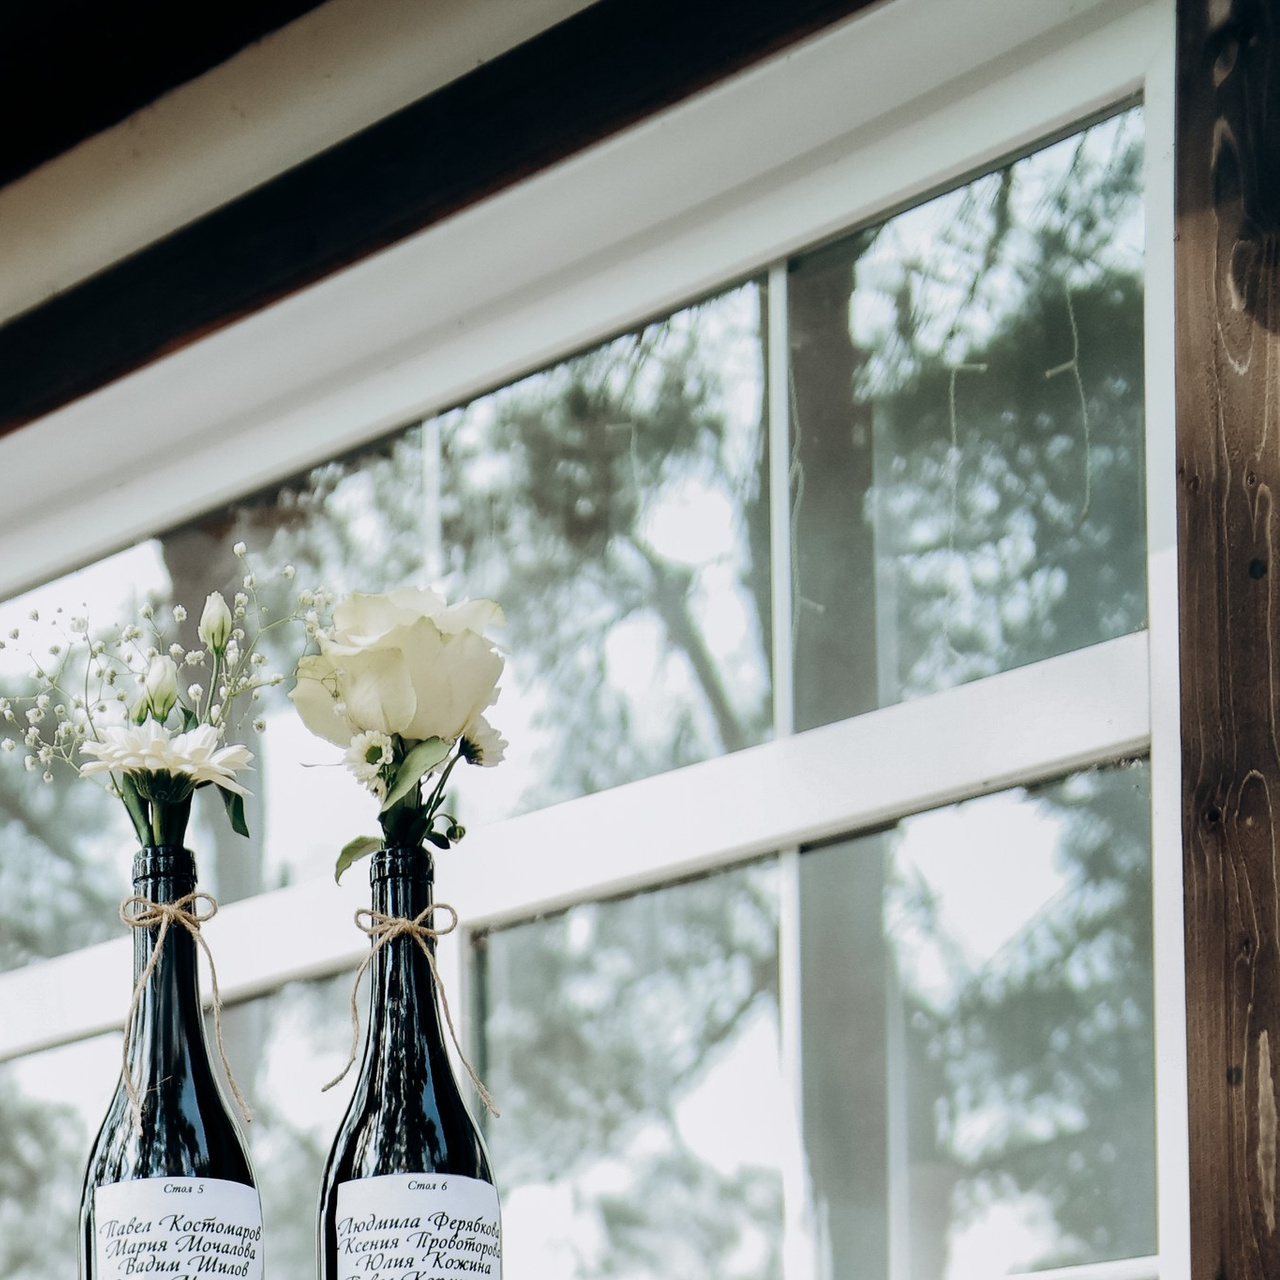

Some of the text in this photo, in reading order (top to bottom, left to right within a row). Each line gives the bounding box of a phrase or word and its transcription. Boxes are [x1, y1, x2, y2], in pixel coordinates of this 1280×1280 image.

[163, 1184, 204, 1194] Стол 5
[407, 1180, 448, 1191] Стол 6
[99, 1214, 261, 1244] Павел Костомаров
[337, 1212, 500, 1239] Людмила Ферябкова
[105, 1235, 256, 1261] Мария Мочалова
[337, 1237, 399, 1255] Ксения
[118, 1255, 250, 1277] Вадим Шилов
[355, 1251, 491, 1275] Юлия Кожина
